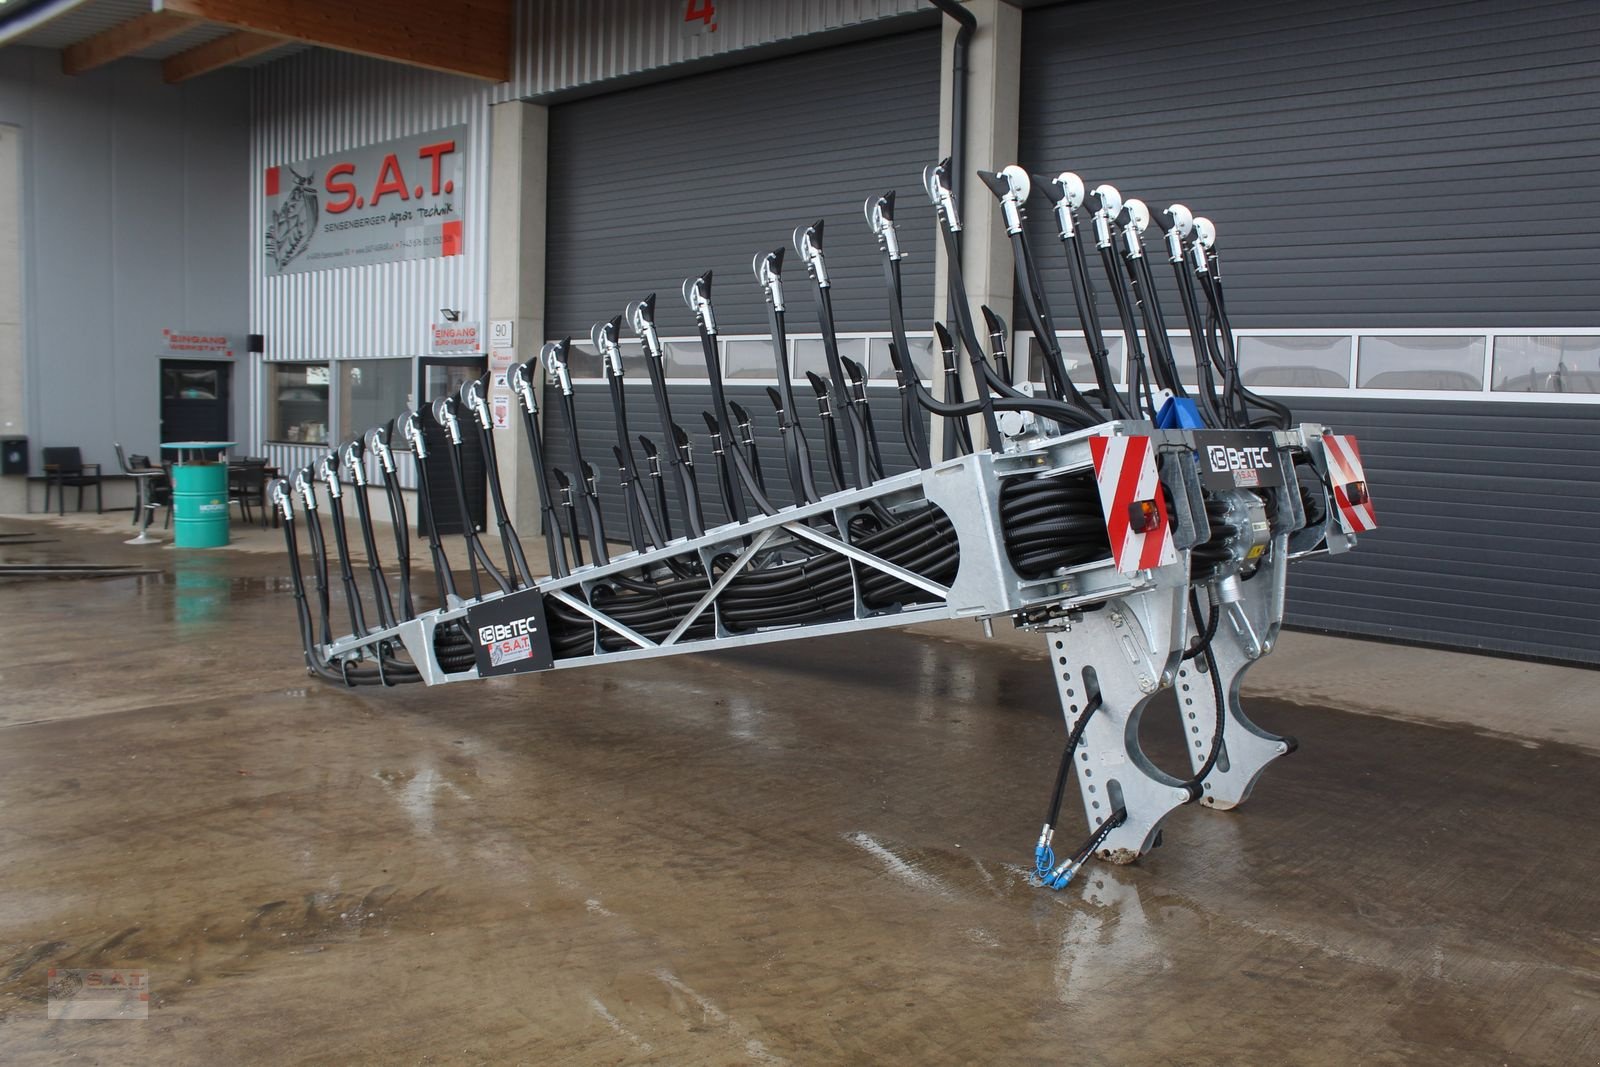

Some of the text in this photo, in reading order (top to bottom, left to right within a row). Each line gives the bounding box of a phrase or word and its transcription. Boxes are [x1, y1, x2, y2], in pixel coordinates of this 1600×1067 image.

[325, 140, 455, 214] S.A.T.
[324, 215, 386, 233] SENSENBERGER
[417, 202, 453, 218] Technik
[435, 328, 476, 338] EINGANG
[496, 324, 507, 337] 90
[502, 637, 530, 653] S.A.T.
